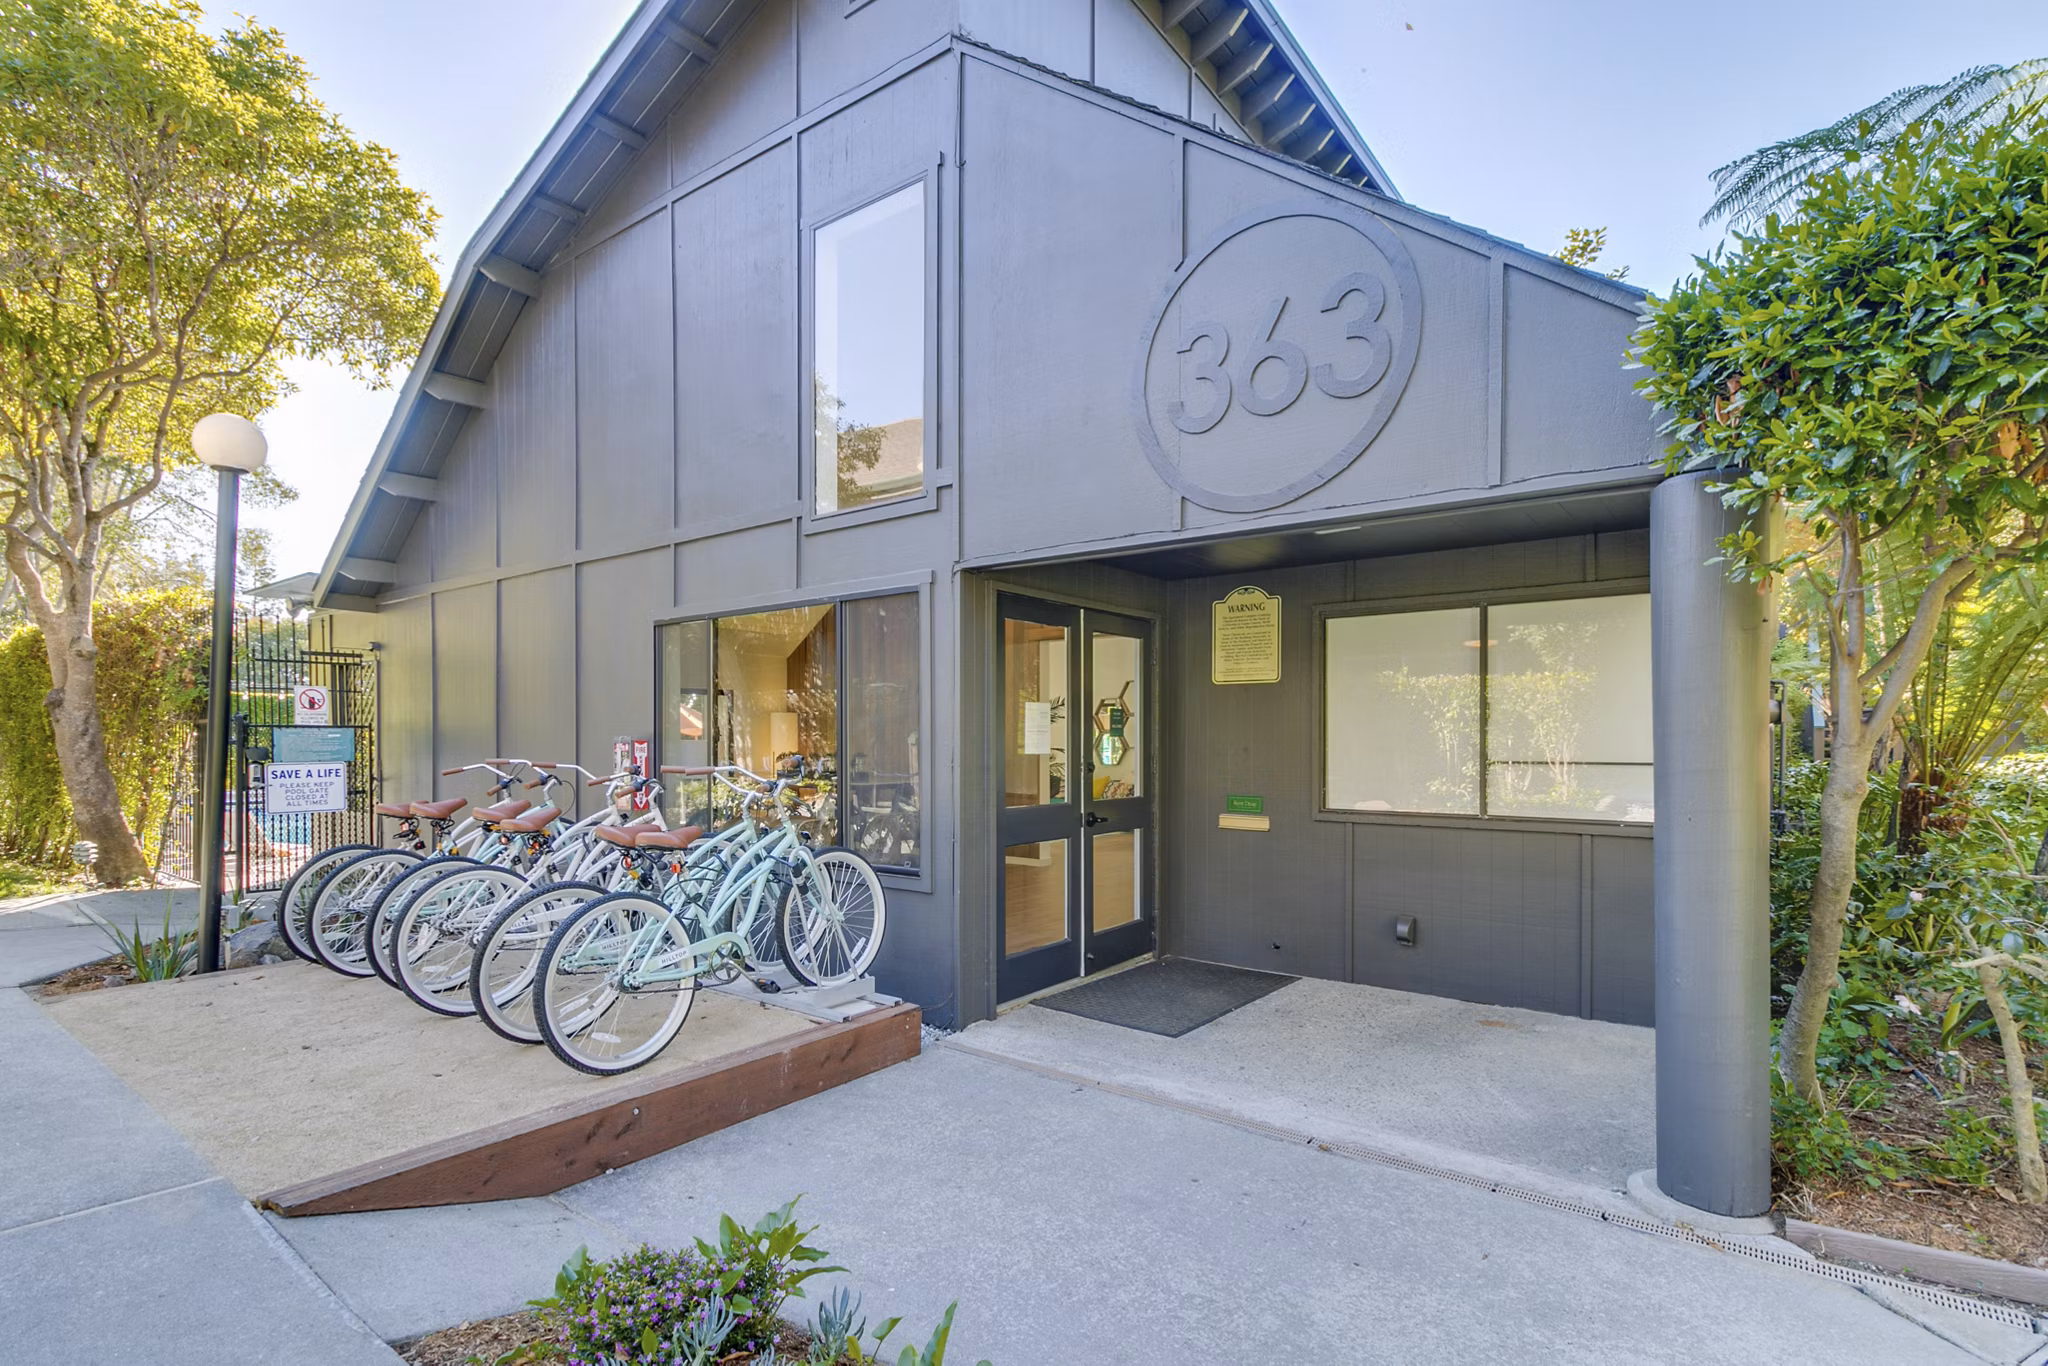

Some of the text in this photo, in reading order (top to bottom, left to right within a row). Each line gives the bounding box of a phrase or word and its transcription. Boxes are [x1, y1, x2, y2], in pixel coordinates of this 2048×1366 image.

[1167, 272, 1392, 435] 363
[1227, 602, 1266, 613] WARNING
[636, 746, 646, 754] FIRE
[271, 768, 342, 780] SAVE A LIFE
[602, 939, 628, 951] HILLTOP
[661, 950, 687, 964] HILLTOP
